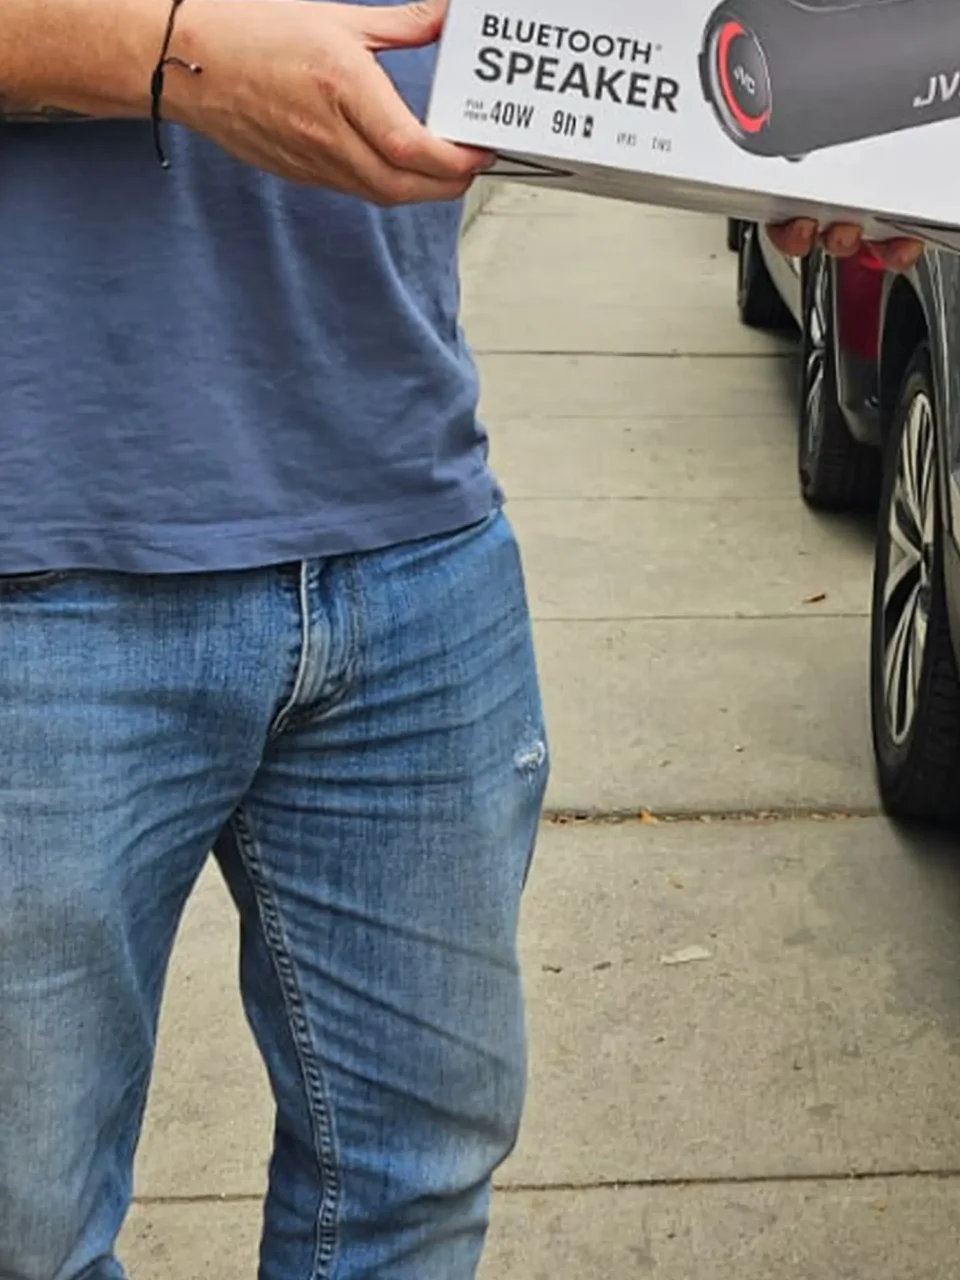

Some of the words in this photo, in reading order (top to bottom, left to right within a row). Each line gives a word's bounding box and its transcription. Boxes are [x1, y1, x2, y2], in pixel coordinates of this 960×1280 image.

[481, 14, 652, 64] BLUETOOTH
[474, 46, 680, 113] SPEAKER
[490, 100, 534, 129] 40W
